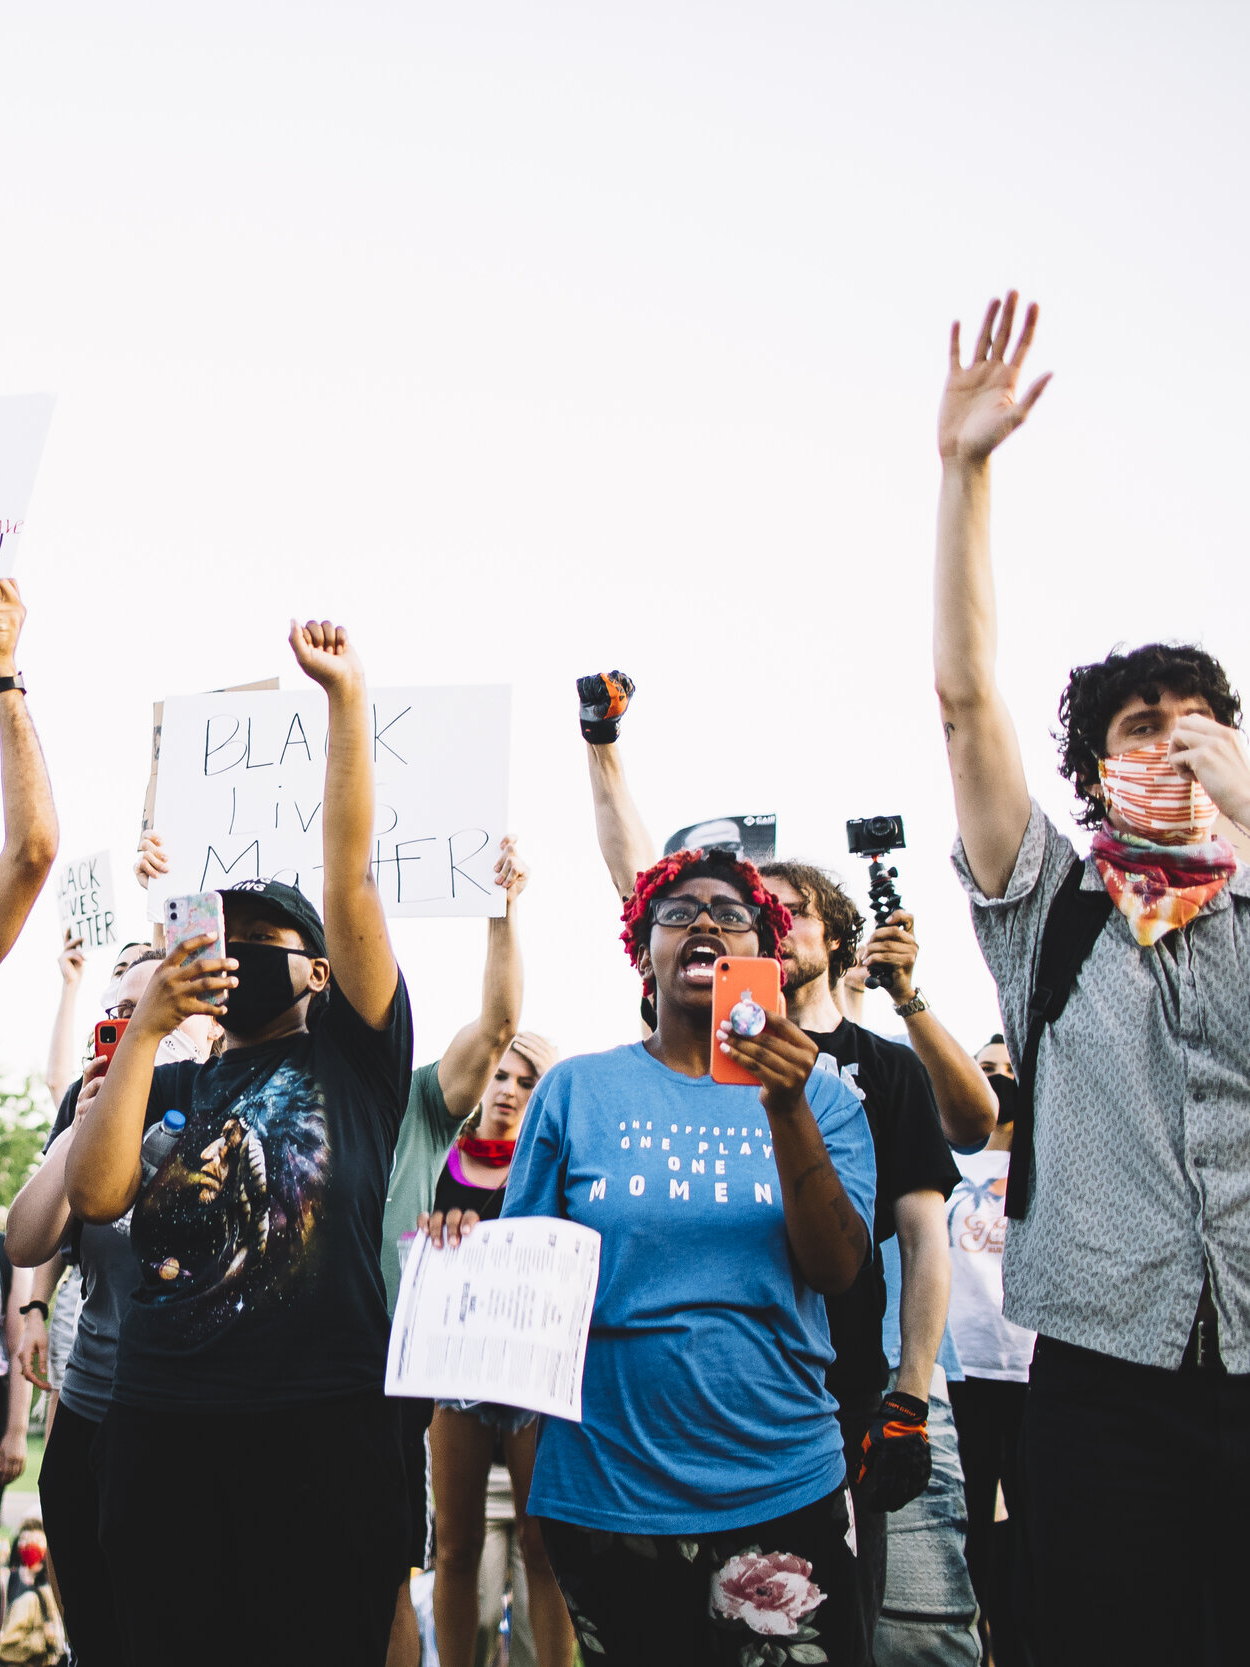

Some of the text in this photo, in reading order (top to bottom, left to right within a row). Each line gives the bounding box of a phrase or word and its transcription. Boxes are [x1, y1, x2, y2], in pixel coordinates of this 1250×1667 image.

[203, 703, 412, 776] BLAK
[619, 1119, 653, 1132] ONE
[620, 1135, 773, 1160] ONE PLAY
[667, 1155, 726, 1175] ONE
